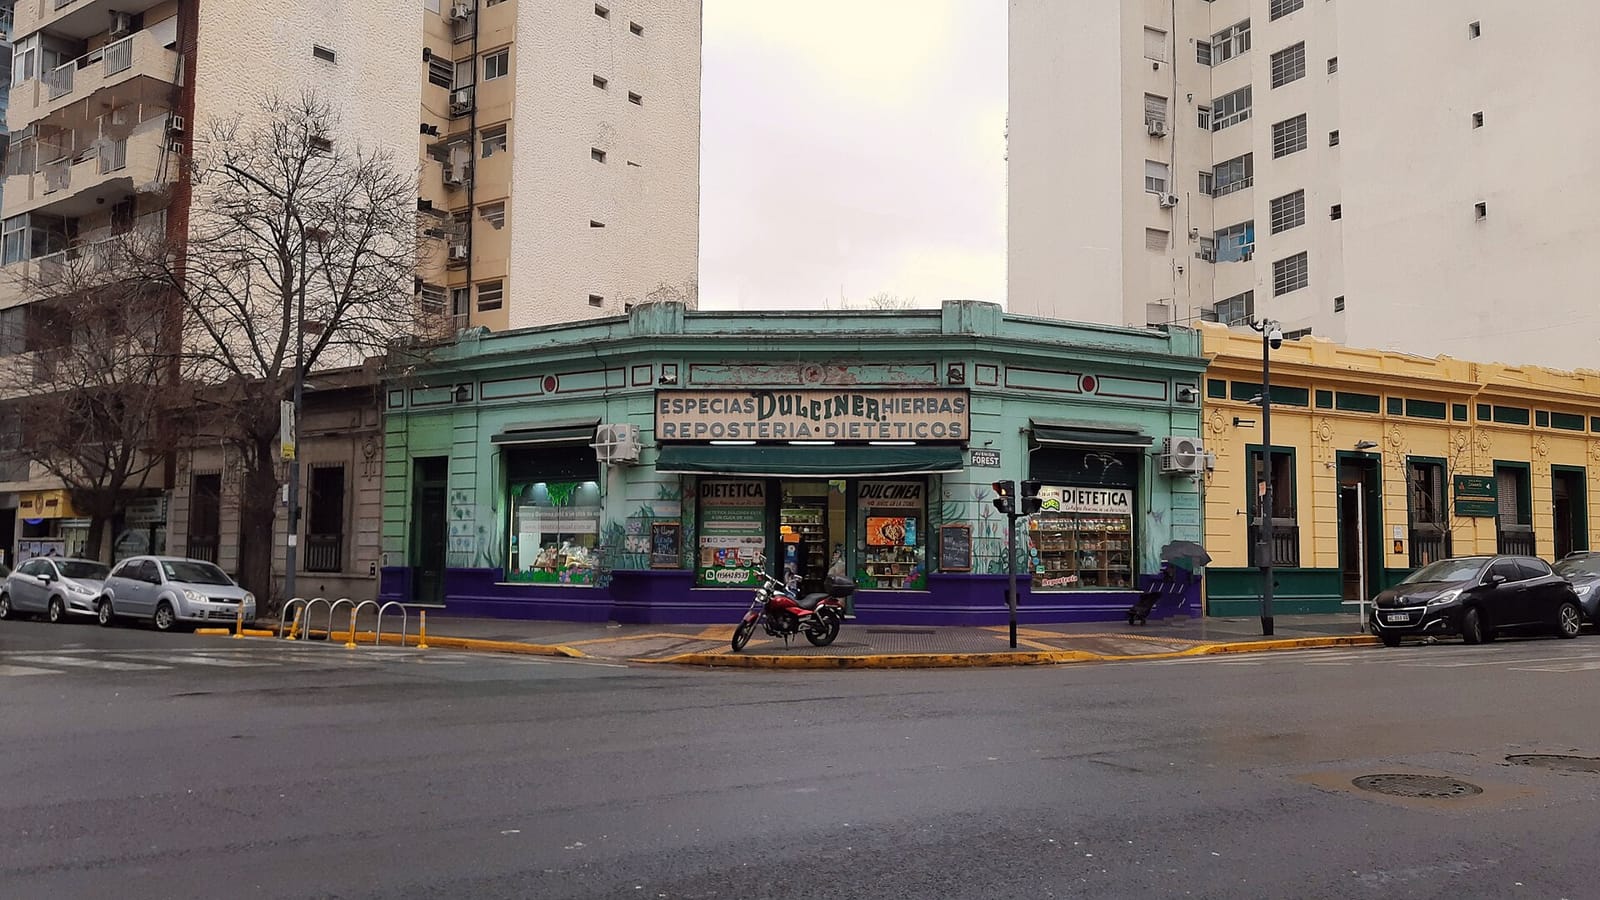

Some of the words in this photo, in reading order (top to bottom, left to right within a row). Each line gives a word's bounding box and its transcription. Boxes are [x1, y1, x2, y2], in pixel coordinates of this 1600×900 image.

[659, 398, 755, 415] ESPECIAS
[882, 398, 965, 414] HIERBAS
[663, 422, 812, 438] REPOSTERIA
[825, 422, 962, 438] DIETETICOS
[972, 456, 999, 465] FOREST
[702, 483, 764, 497] DIETETICA
[860, 484, 920, 499] DULCINEA
[1062, 489, 1127, 506] DIETETICA
